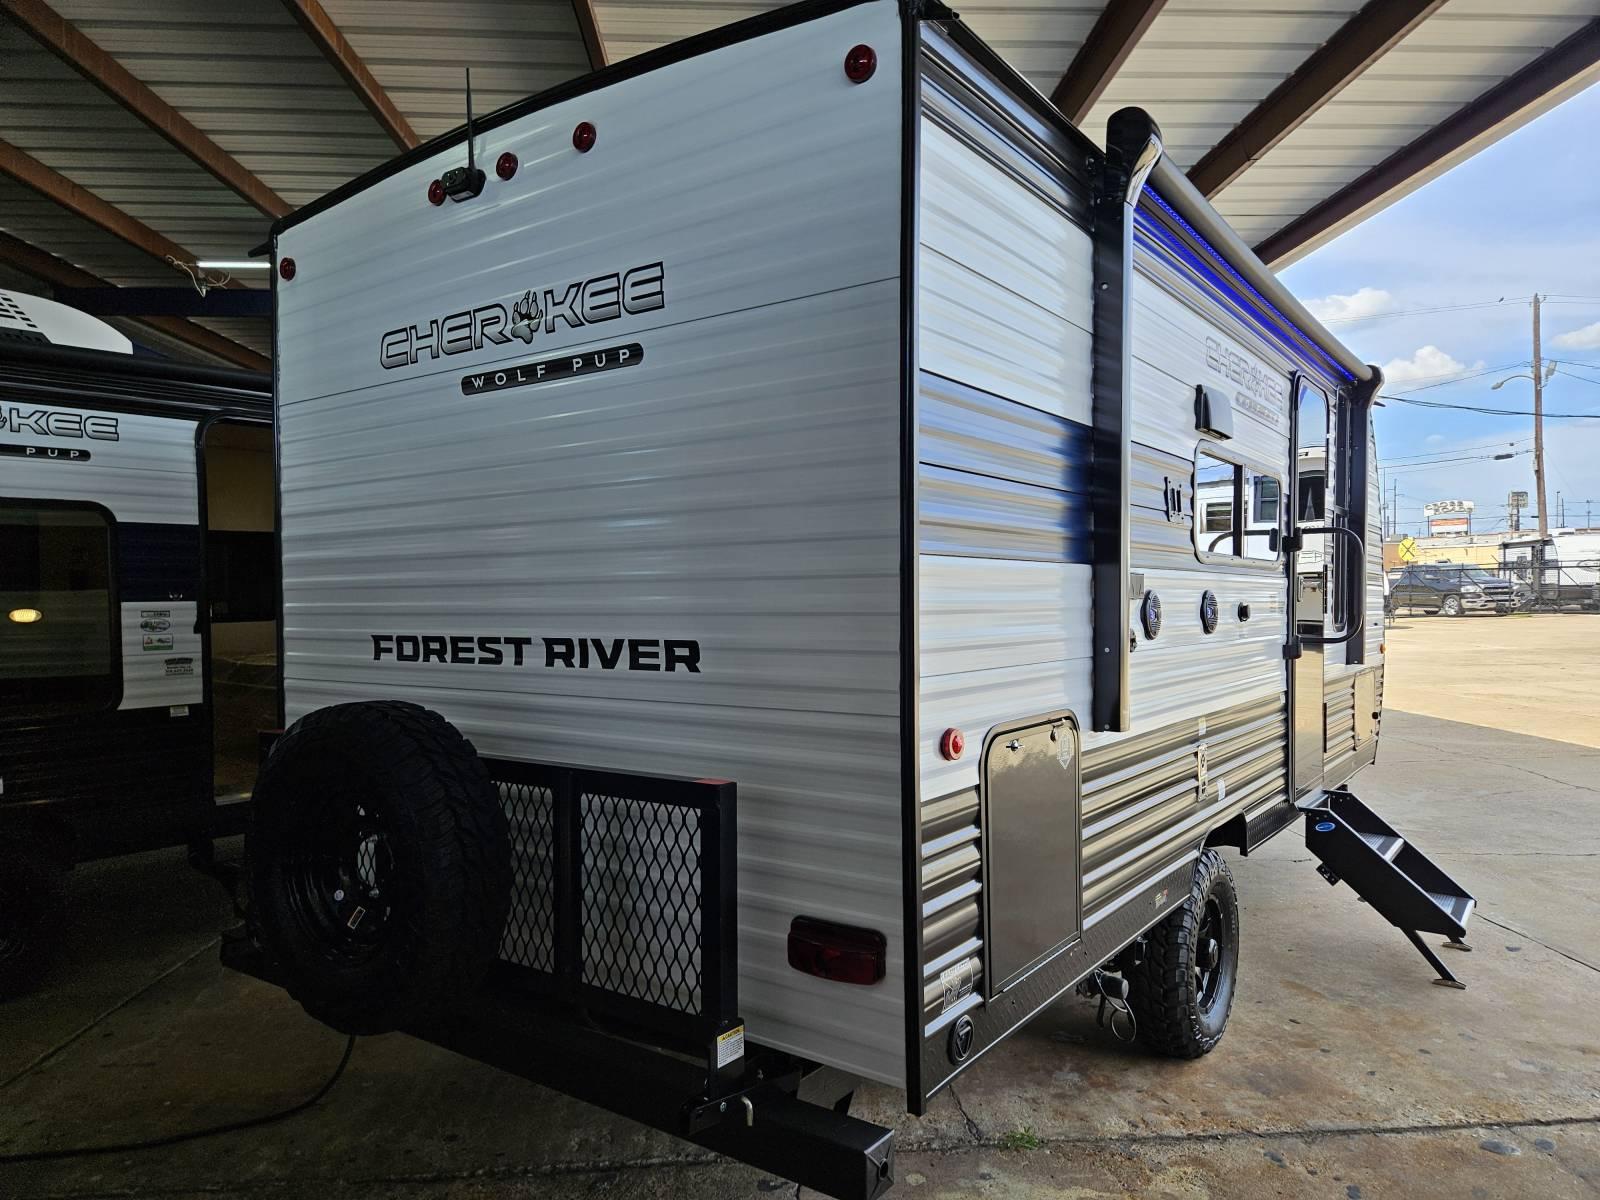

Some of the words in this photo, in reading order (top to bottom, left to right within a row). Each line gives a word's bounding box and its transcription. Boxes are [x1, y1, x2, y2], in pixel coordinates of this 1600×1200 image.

[380, 261, 665, 370] CHERKEE
[471, 365, 547, 390] WOLF
[572, 348, 631, 372] PUP
[26, 447, 79, 459] PUP
[370, 634, 532, 666] FOREST
[541, 637, 702, 673] RIVER
